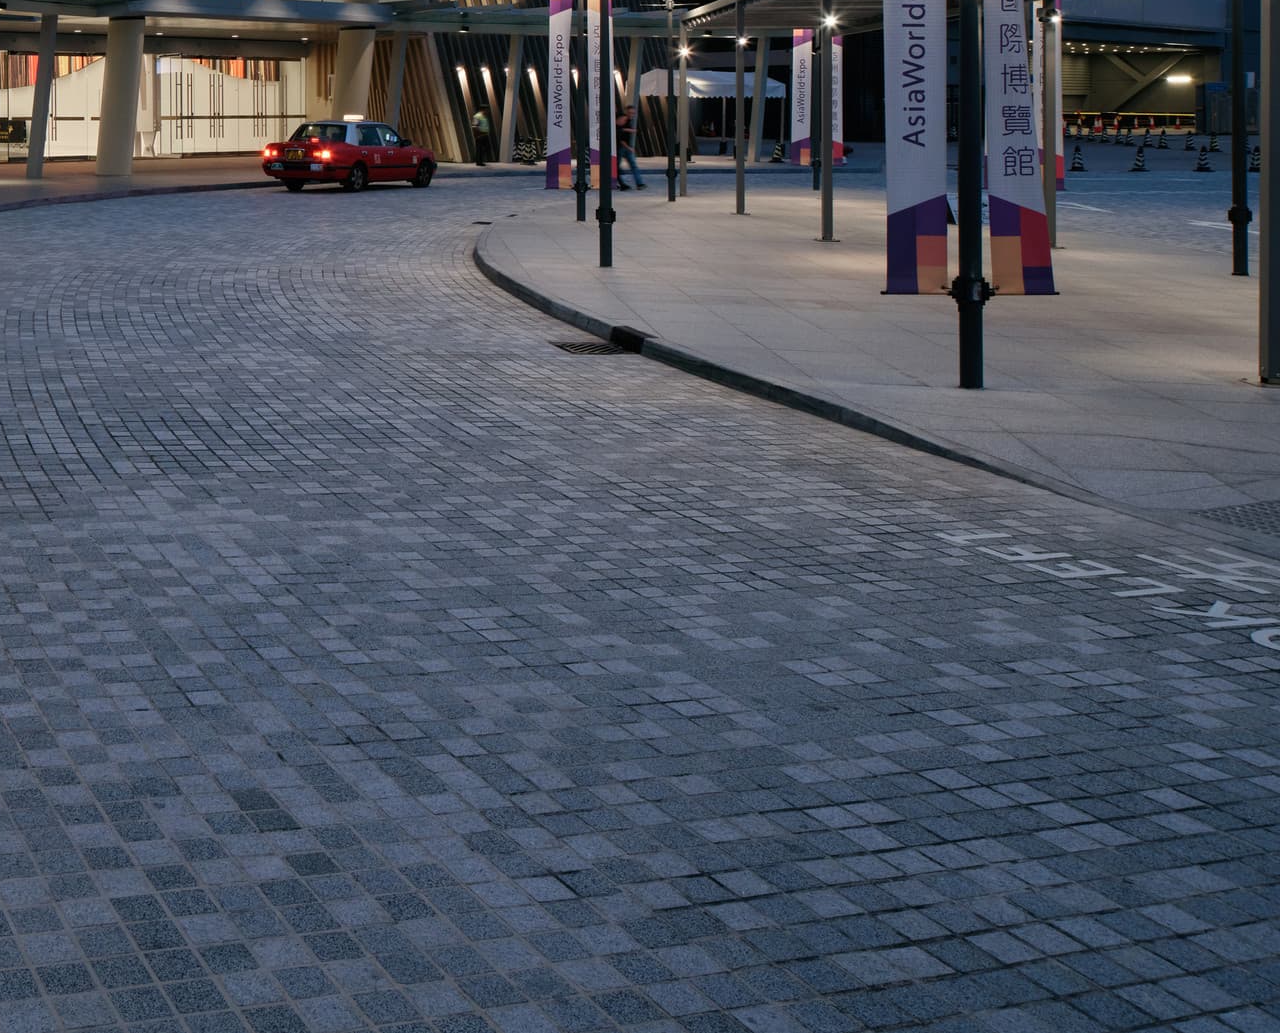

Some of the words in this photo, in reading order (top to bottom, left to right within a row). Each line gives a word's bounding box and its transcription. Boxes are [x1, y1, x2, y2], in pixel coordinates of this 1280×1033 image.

[553, 34, 565, 129] AsiaWorld-Expo
[796, 58, 807, 124] AsiaWorld-Expo
[934, 532, 1186, 598] LEFT
